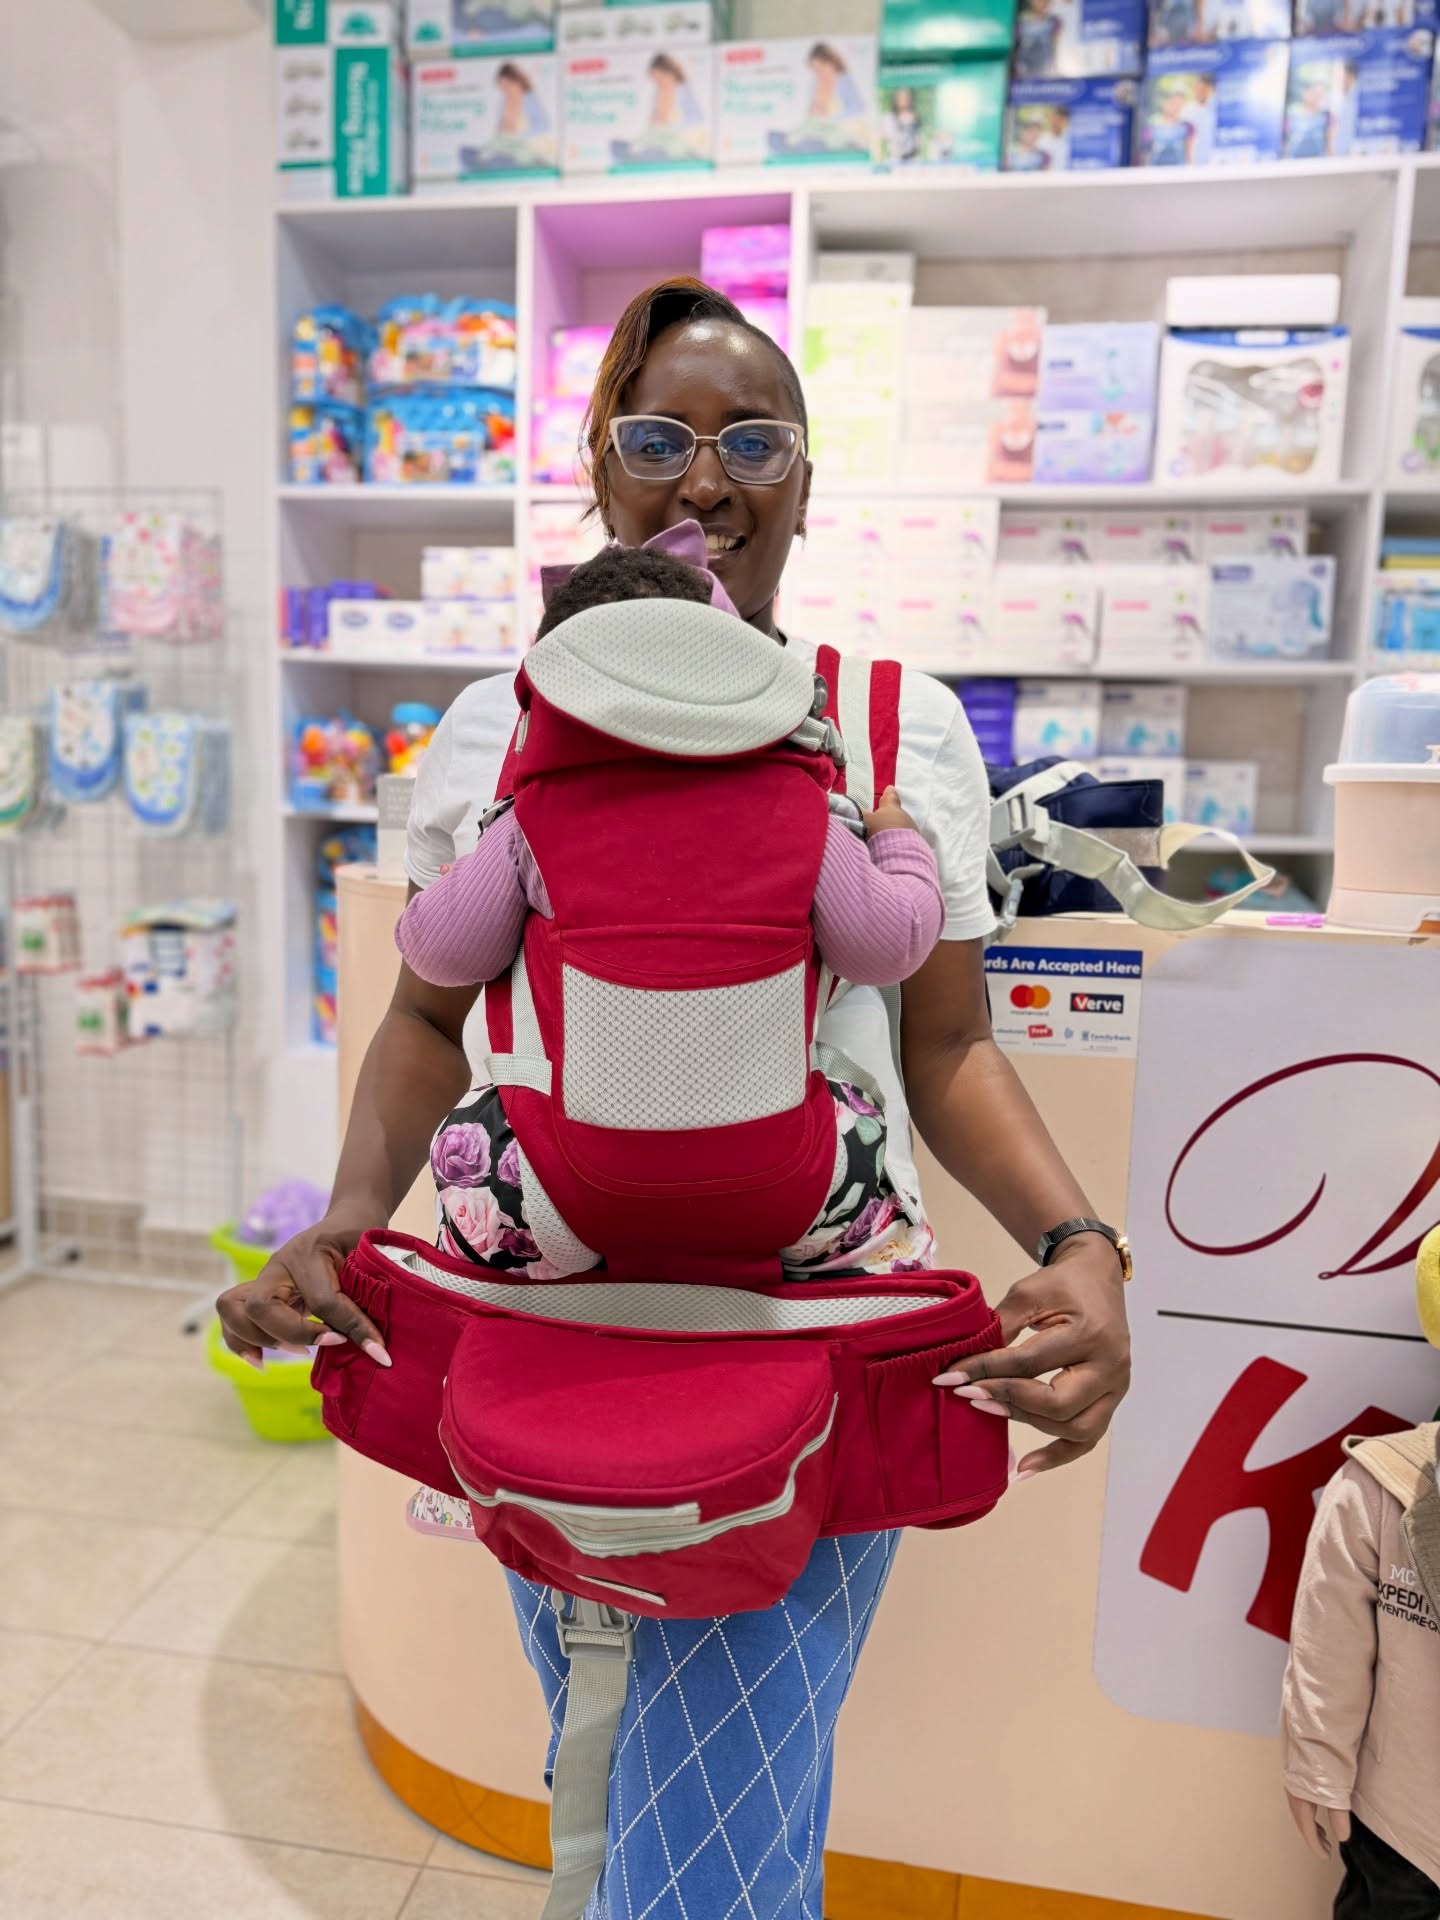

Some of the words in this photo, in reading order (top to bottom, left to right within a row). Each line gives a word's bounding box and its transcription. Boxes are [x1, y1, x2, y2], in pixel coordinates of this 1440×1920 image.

[1010, 957, 1035, 971] Are
[1038, 959, 1103, 975] Accepted
[1106, 961, 1141, 975] Here
[1075, 995, 1122, 1012] Verve
